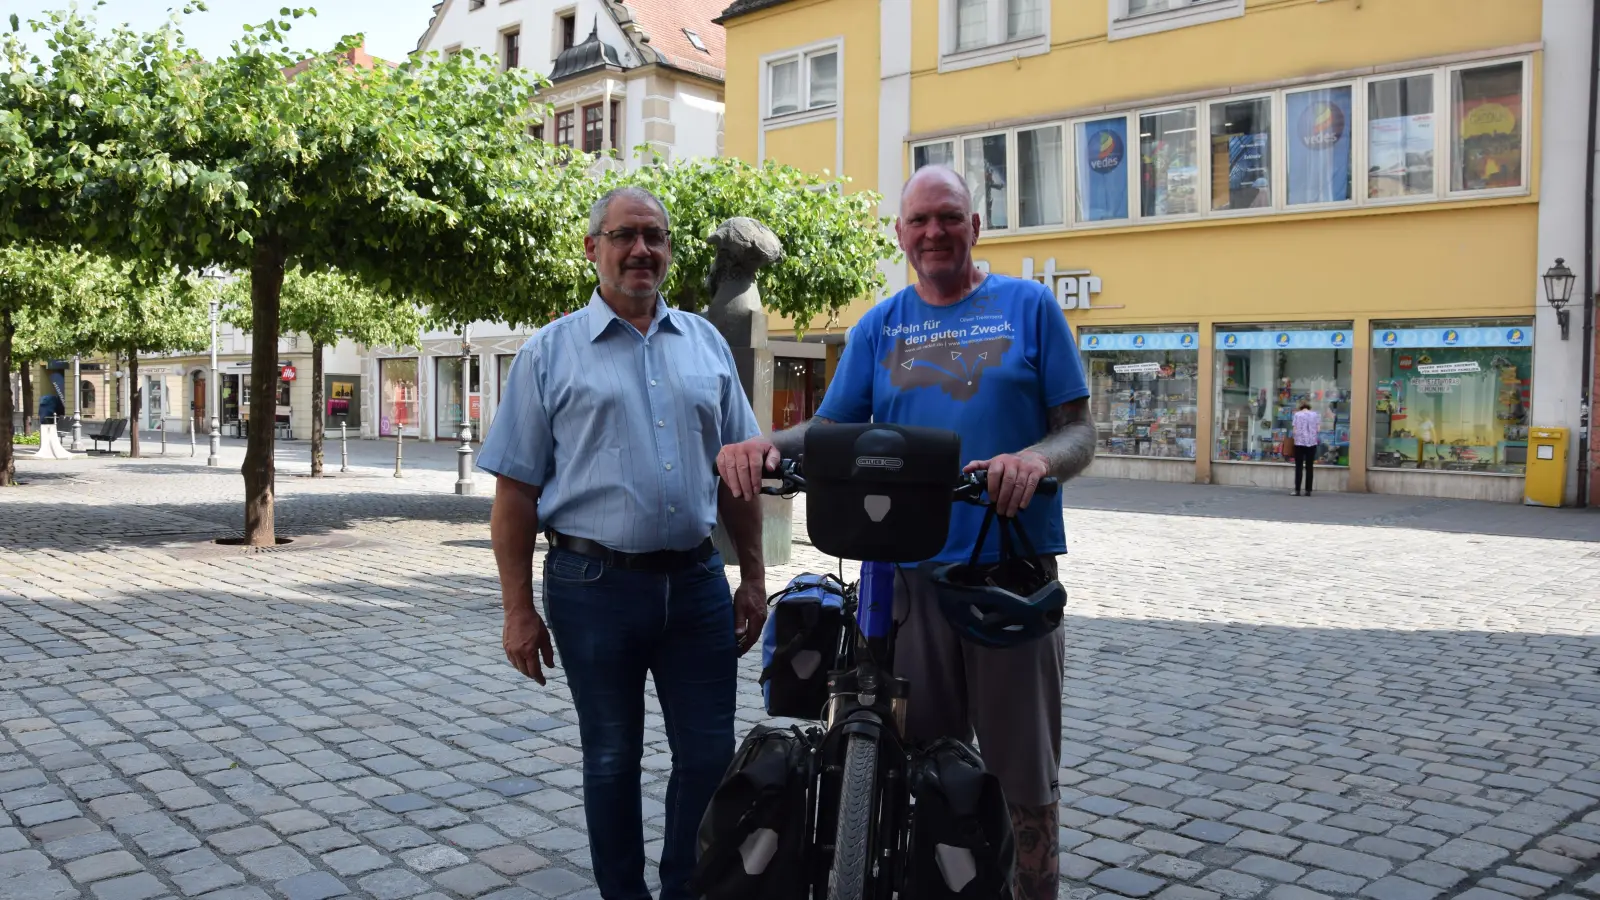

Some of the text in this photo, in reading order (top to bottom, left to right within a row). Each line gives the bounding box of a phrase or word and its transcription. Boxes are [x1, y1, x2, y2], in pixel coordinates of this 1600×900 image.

[1303, 132, 1337, 145] vedes
[1091, 157, 1118, 169] vedes
[882, 319, 941, 337] Radeln für
[905, 335, 927, 346] den
[930, 327, 967, 342] guten
[970, 320, 1015, 336] Zweck.
[282, 368, 295, 380] illy
